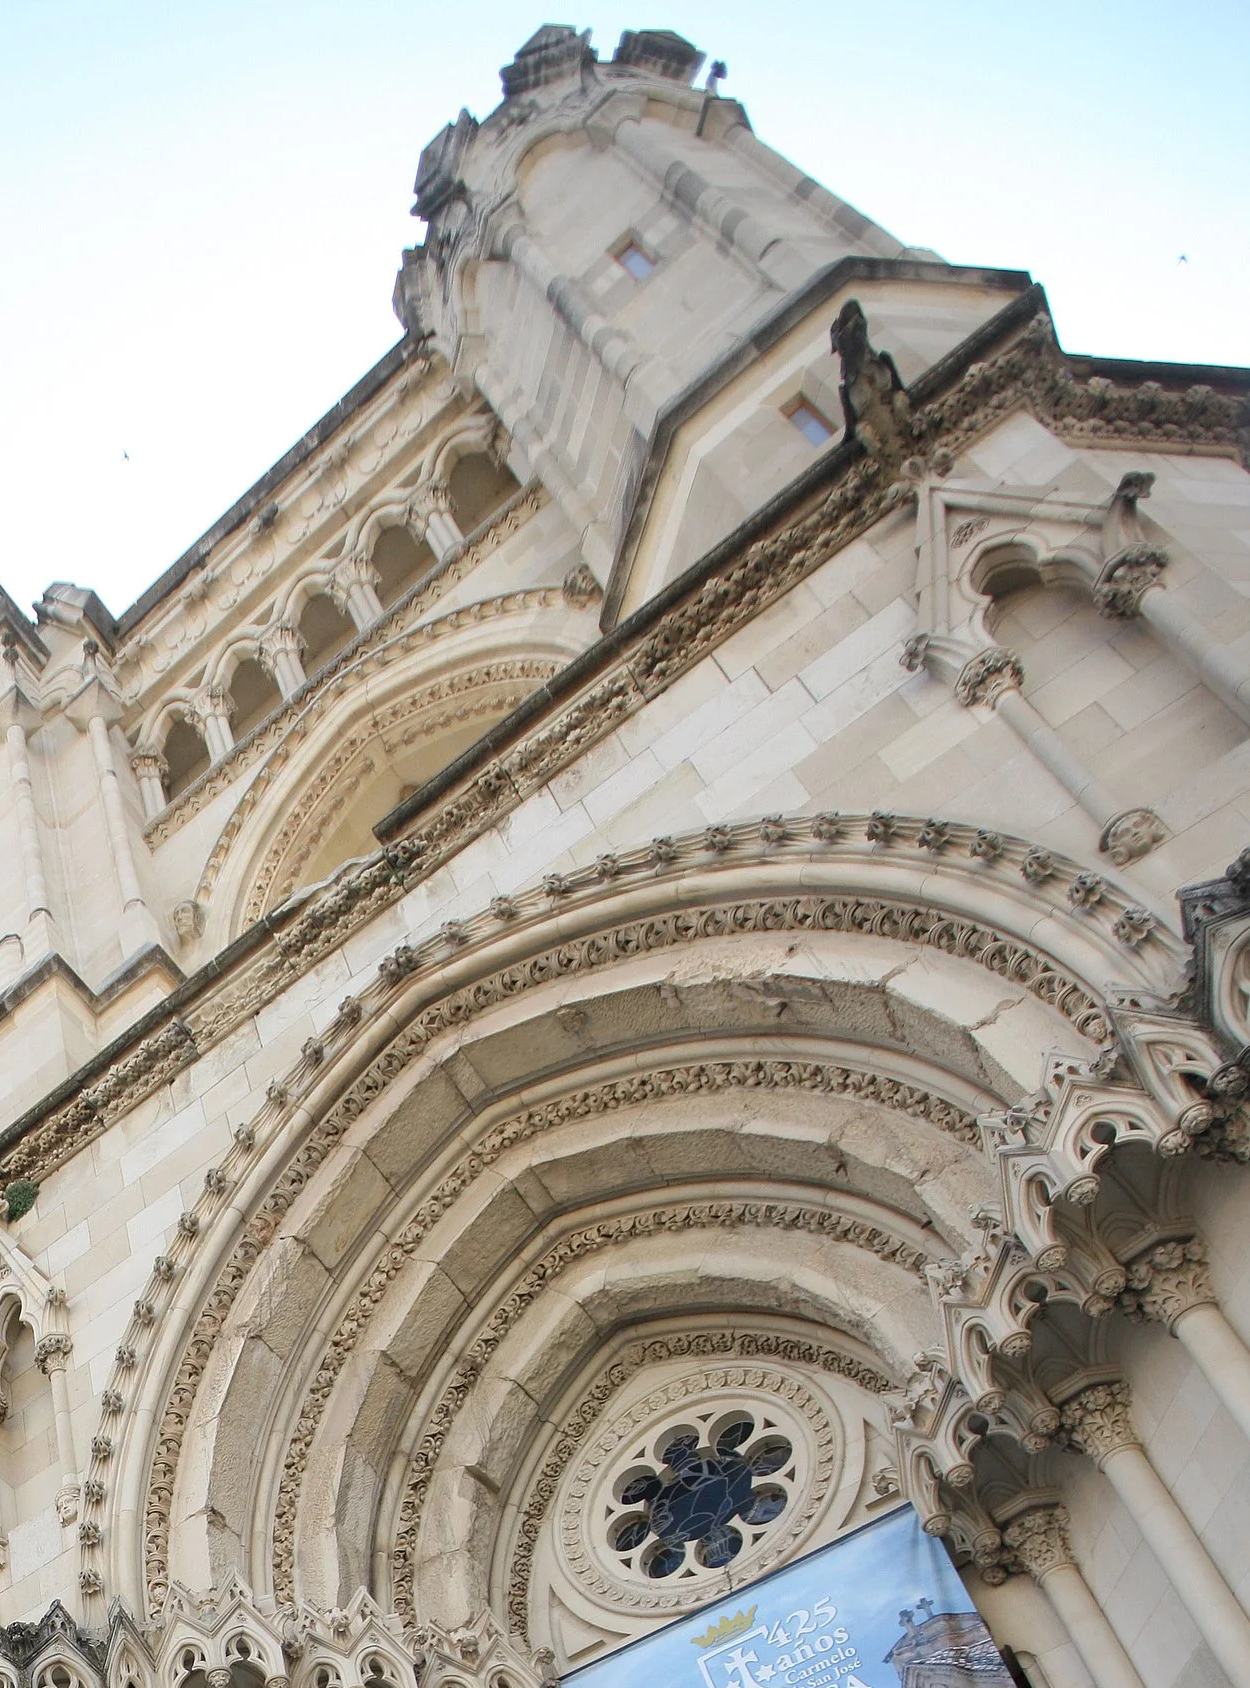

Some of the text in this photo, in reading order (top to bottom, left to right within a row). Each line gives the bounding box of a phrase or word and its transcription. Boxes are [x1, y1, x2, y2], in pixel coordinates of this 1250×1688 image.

[767, 1596, 838, 1648] 425
[776, 1627, 849, 1672] años
[784, 1647, 856, 1685] Carmelo
[834, 1657, 862, 1685] José
